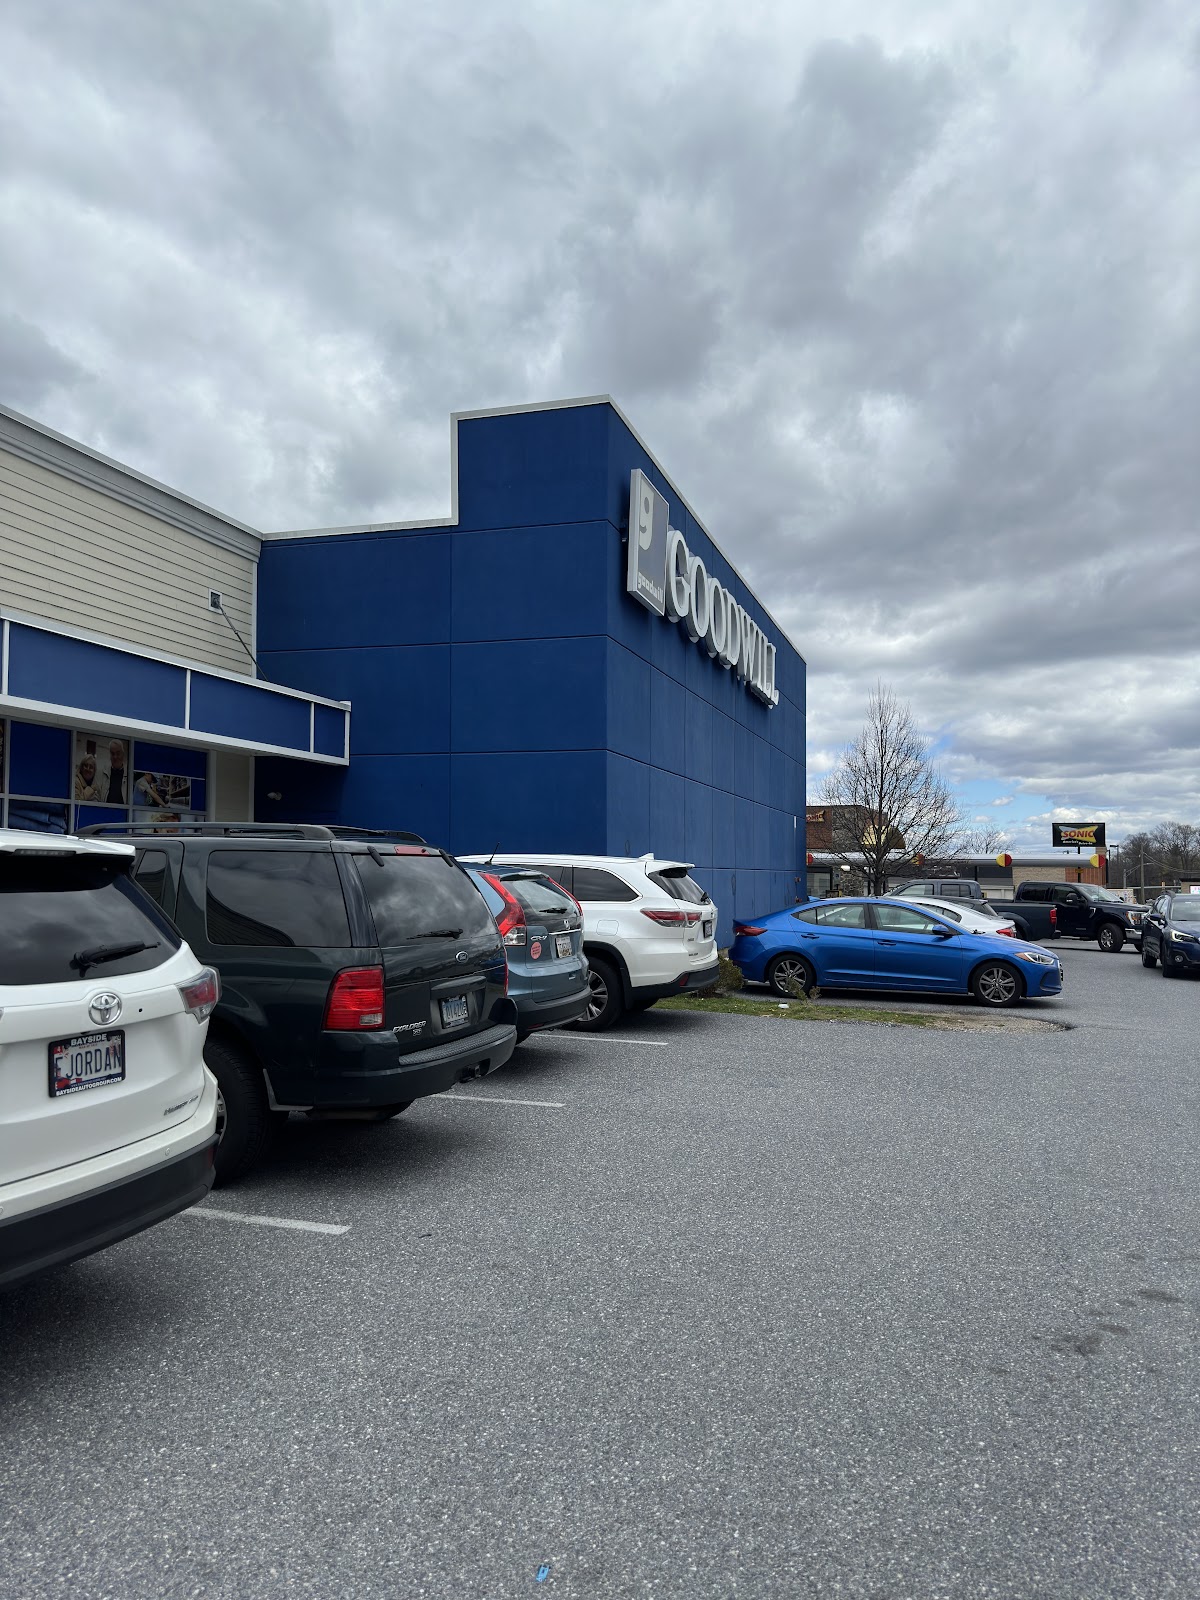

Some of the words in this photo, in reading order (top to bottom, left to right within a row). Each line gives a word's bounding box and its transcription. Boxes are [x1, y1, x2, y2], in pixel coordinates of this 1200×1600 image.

[667, 529, 779, 708] GOODWILL
[1063, 830, 1094, 838] SONIC
[393, 1020, 427, 1033] EXPLORER
[71, 1034, 107, 1046] BAYSIDE
